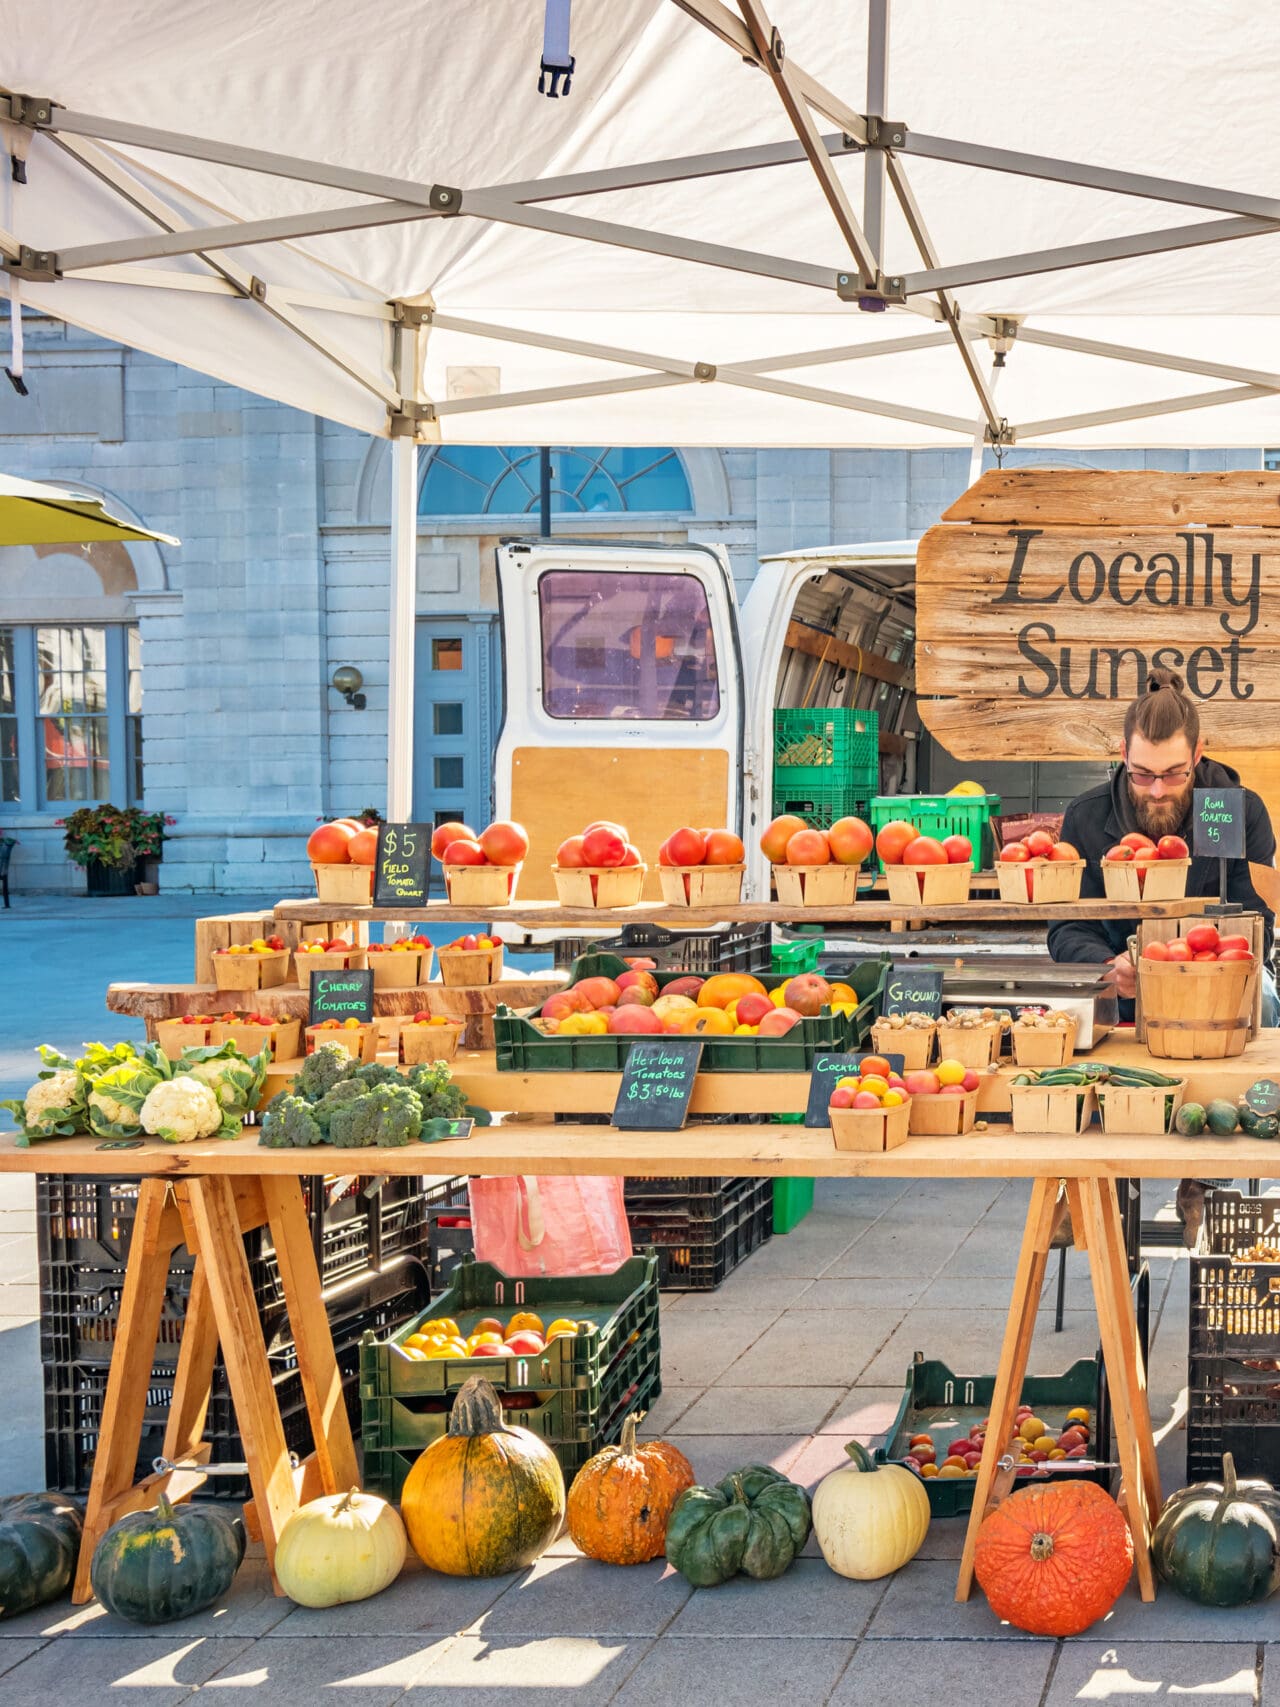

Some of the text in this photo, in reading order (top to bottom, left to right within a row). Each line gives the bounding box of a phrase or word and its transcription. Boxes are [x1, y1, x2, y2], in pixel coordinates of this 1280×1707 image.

[991, 529, 1261, 636] Locally
[1017, 622, 1257, 699] Sunset
[1200, 810, 1233, 823] TOMATOES
[1207, 826, 1220, 843] $5
[383, 829, 417, 857] $5
[383, 859, 409, 875] FIELD
[386, 873, 415, 886] TOMATO
[396, 888, 424, 897] QUART
[318, 979, 363, 993] CHERRY
[888, 982, 941, 1003] GROUND
[314, 994, 367, 1011] TOMATOES
[630, 1066, 686, 1079] Tomatoes
